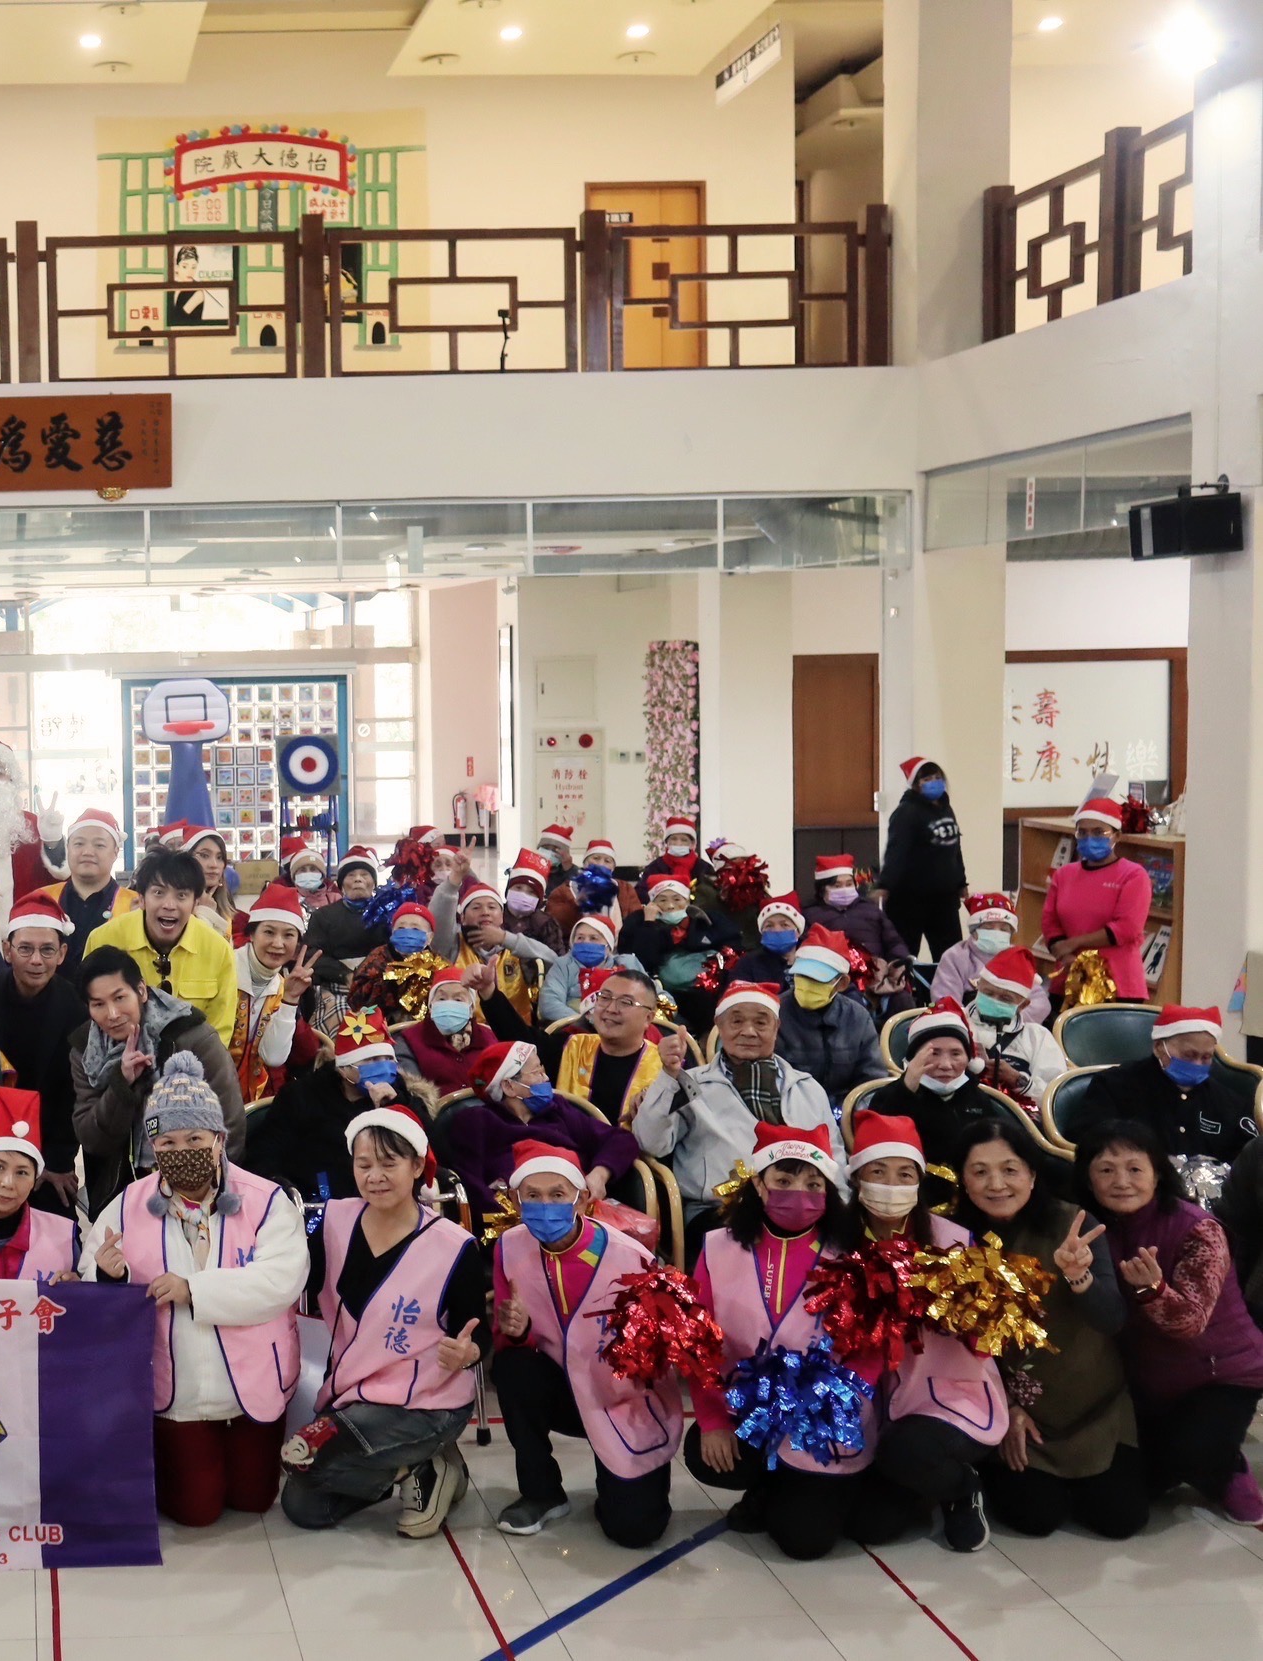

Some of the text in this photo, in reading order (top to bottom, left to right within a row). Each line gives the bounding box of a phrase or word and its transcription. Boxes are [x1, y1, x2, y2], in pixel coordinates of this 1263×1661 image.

[552, 769, 588, 780] 消防栓
[781, 1142, 806, 1152] Merry
[384, 1295, 421, 1354] 怡德
[8, 1525, 61, 1542] CLUB
